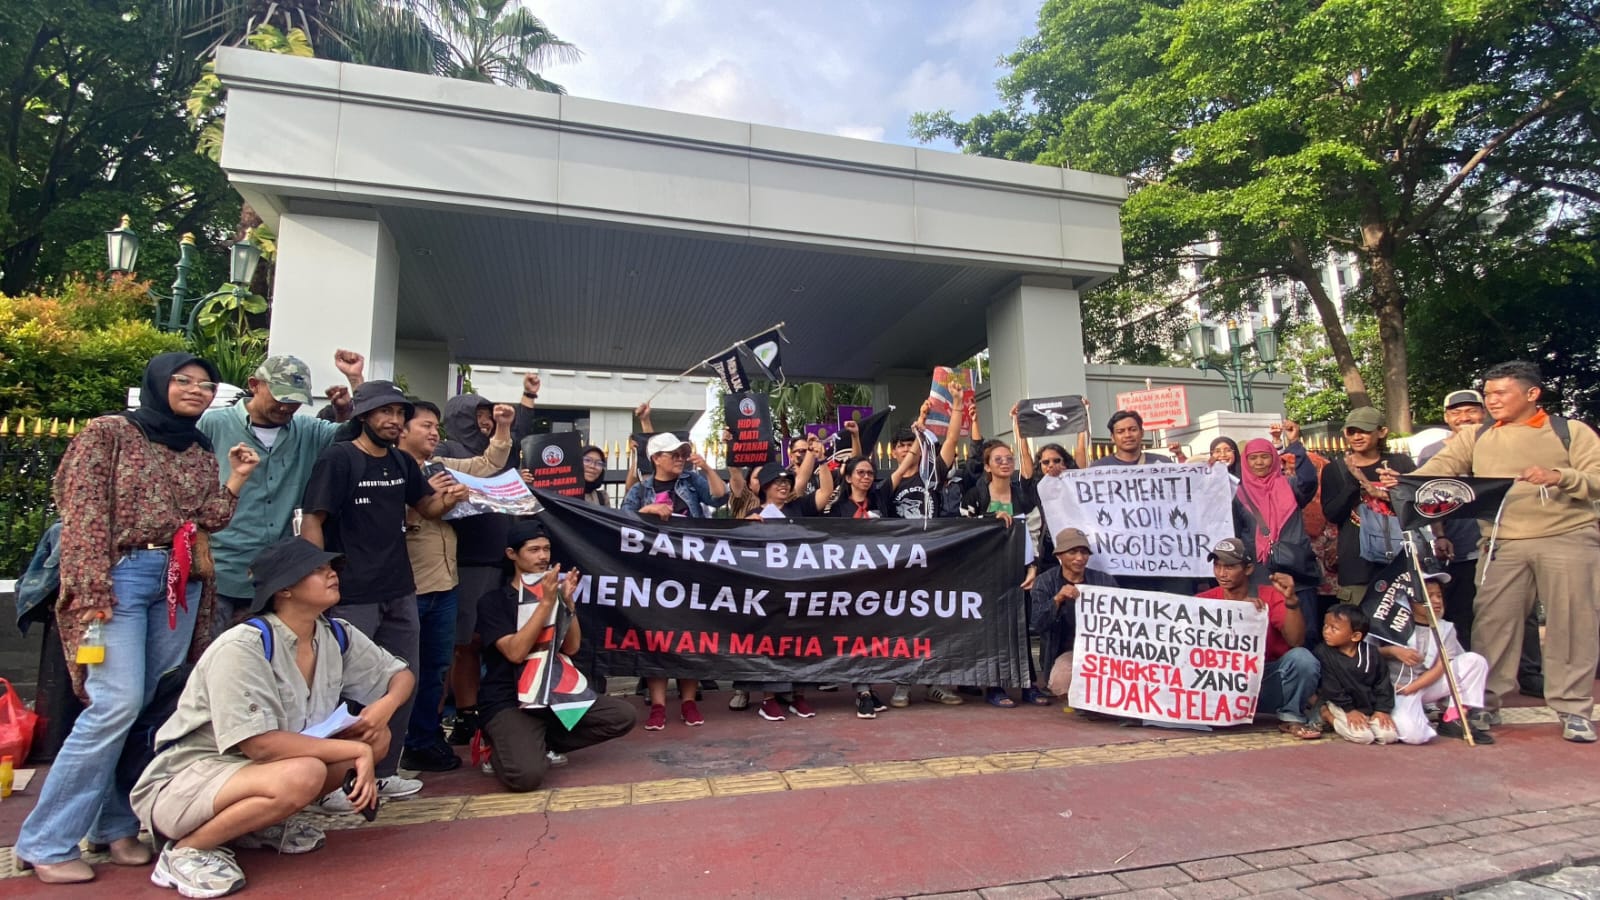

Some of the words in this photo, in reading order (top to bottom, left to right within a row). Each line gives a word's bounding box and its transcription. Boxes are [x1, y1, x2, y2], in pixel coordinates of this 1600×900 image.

[1122, 393, 1153, 404] PEJALAN
[1155, 391, 1173, 400] KAKI
[1153, 401, 1179, 409] MOTOR
[737, 418, 762, 428] HIDUP
[1150, 409, 1182, 418] SAMPING
[733, 441, 769, 451] DITANAH
[739, 430, 760, 441] MATI
[734, 452, 768, 463] SENDIRI
[1151, 466, 1213, 476] BERSATU
[1075, 477, 1192, 505] BERHENTI
[620, 526, 928, 569] BARA-BARAYA
[1088, 531, 1211, 558] NGGUSUR
[1107, 558, 1191, 572] SUNDALA
[784, 588, 983, 619] TERGUSUR
[1080, 592, 1233, 628] HENTIKAN!
[1083, 614, 1149, 640] UPAYA
[1156, 624, 1258, 652] EKSEKUSI
[1389, 606, 1411, 633] MAFI
[604, 626, 719, 654] LAWAN
[729, 633, 823, 657] MAFIA
[833, 635, 931, 659] TANAH
[1081, 633, 1180, 666] TERHADAP
[1189, 647, 1258, 674] OBJEK
[1082, 654, 1183, 688] SENGKETA
[1190, 669, 1248, 692] YANG
[1080, 672, 1163, 715] TIDAK
[1167, 688, 1257, 722] JELAS!
